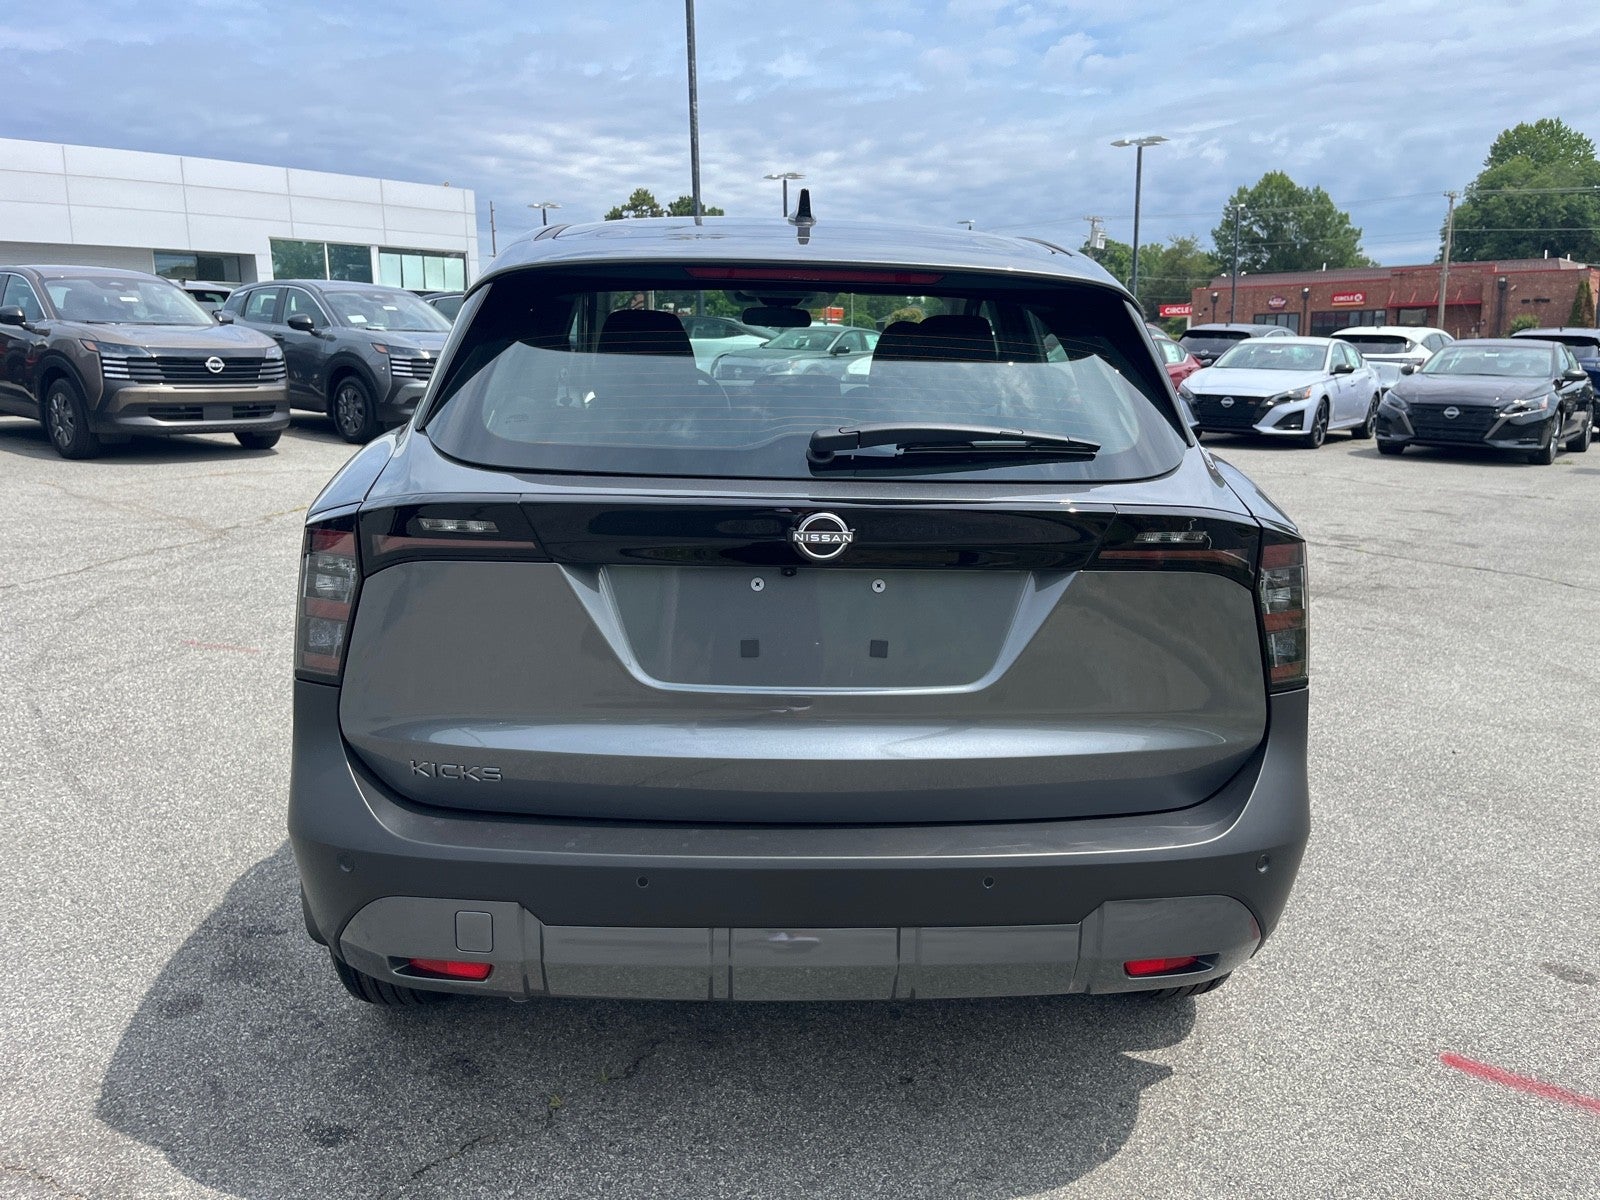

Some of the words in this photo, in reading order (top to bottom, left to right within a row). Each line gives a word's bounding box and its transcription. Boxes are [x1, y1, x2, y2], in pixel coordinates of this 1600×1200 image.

[1334, 294, 1353, 302] CIRCLE
[1164, 306, 1189, 315] CIRCLE
[794, 533, 852, 542] NISSAN
[410, 760, 503, 781] KICKS
